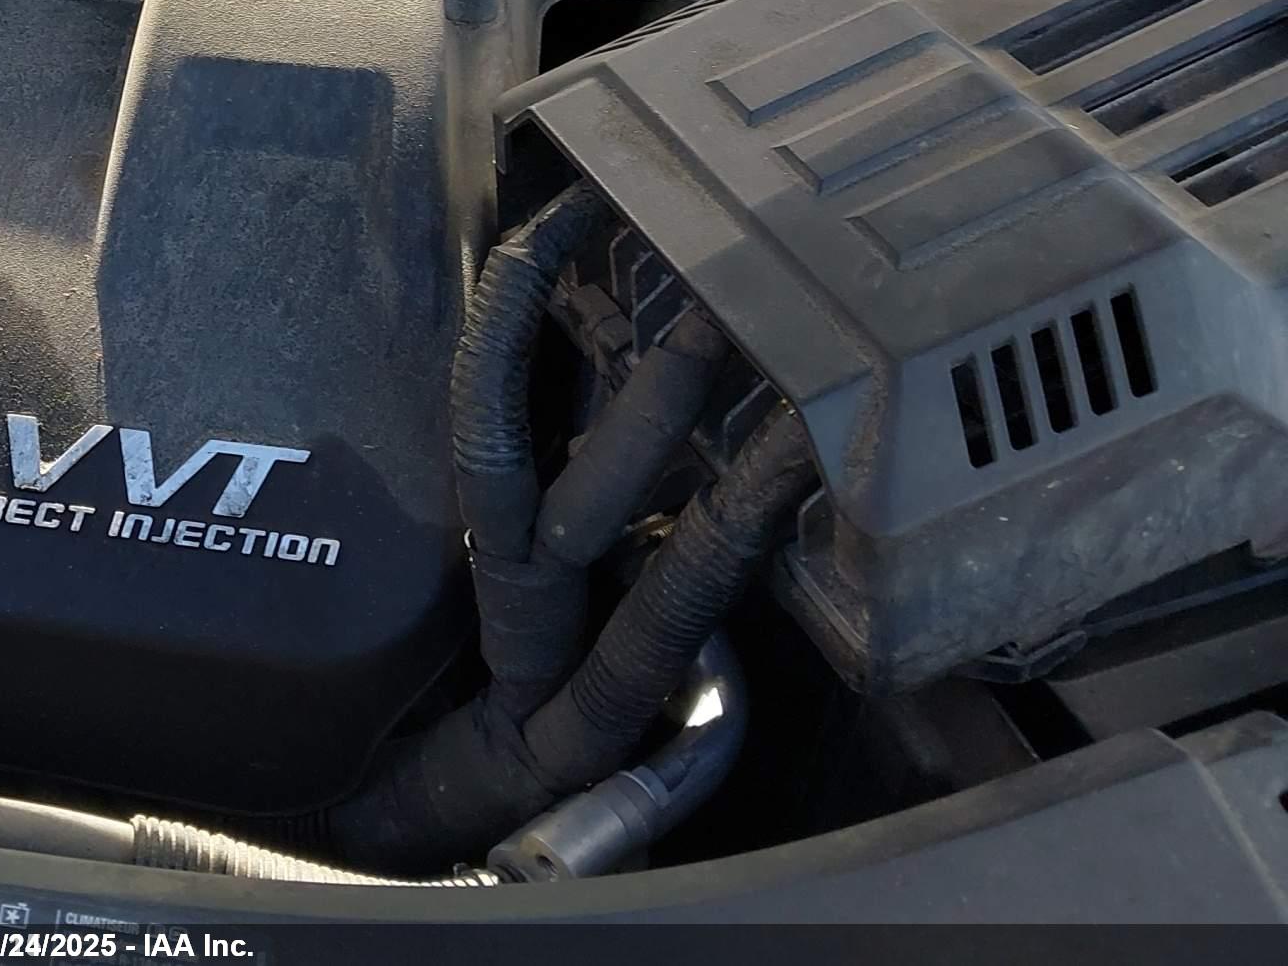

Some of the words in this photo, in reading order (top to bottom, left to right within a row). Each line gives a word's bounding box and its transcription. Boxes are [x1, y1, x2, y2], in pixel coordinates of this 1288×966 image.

[7, 411, 312, 519] VVT
[107, 510, 341, 568] INJECTION
[65, 911, 140, 936] CLIMATISEUR
